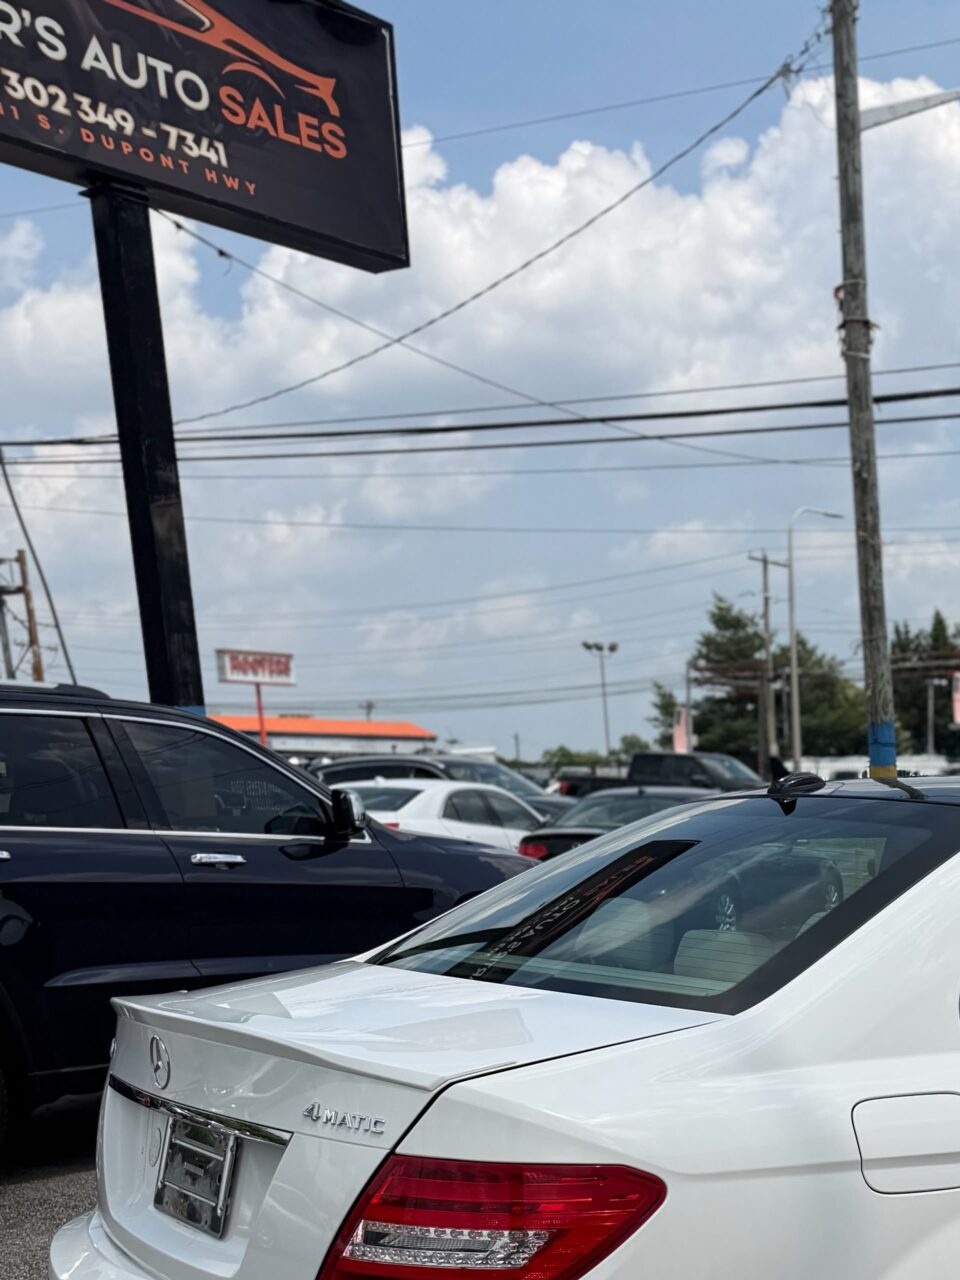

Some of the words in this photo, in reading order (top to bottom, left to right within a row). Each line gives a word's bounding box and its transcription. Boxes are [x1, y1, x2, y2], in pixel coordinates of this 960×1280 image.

[0, 66, 72, 116] 302
[73, 92, 135, 136] 349
[159, 121, 229, 169] 7341
[80, 33, 211, 112] AUTO
[218, 85, 348, 159] SALES
[37, 113, 64, 134] S.
[80, 127, 190, 174] DUPONT
[205, 168, 257, 195] HWY
[303, 1101, 386, 1135] 4MATIC
